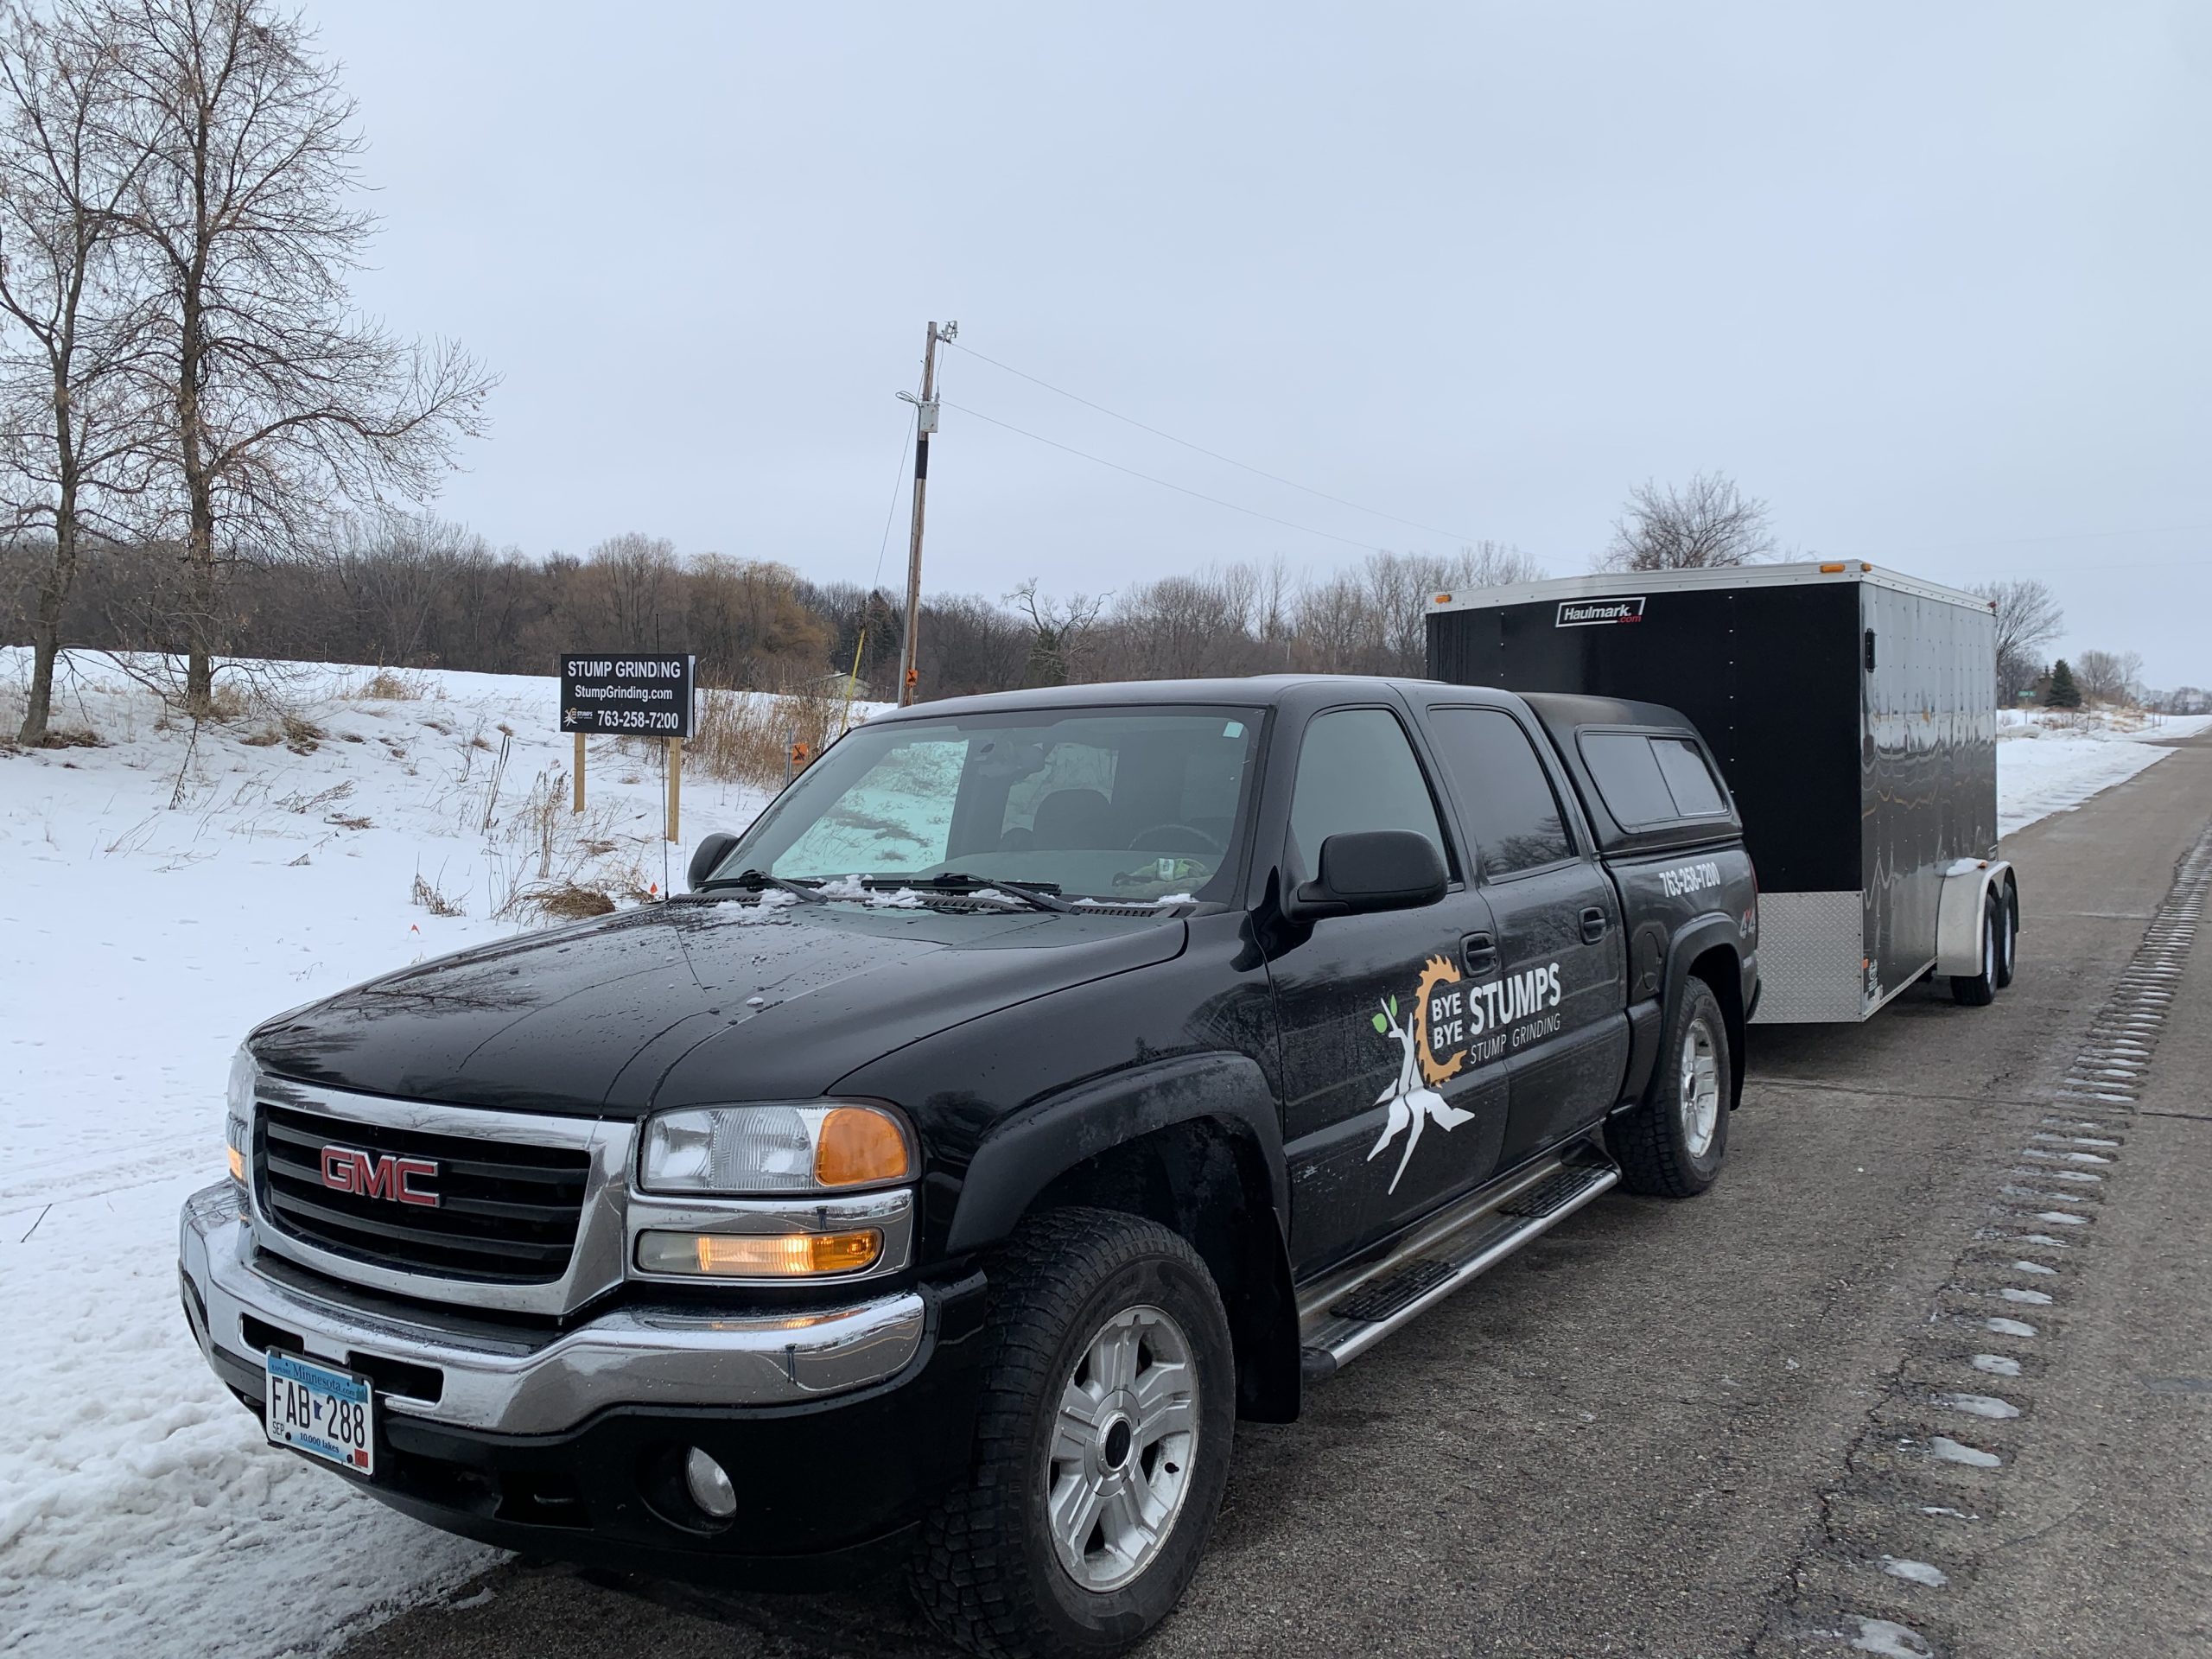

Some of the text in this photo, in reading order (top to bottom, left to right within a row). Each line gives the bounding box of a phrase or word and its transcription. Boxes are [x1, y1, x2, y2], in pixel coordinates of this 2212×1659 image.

[568, 661, 681, 678] STUMP GRINDING
[575, 684, 672, 702] StumpGrinding.com
[597, 710, 678, 729] 763-258-7200
[1659, 861, 1720, 898] 763-258-7200
[1432, 992, 1462, 1022] BYE
[1470, 962, 1561, 1035] STUMPS
[1433, 1020, 1463, 1050] BYE
[1470, 1013, 1561, 1065] STUMP GRINDING
[321, 1145, 440, 1208] GMC
[272, 1376, 365, 1449] FAB 288
[272, 1421, 284, 1436] SEP
[322, 1440, 340, 1453] lakes
